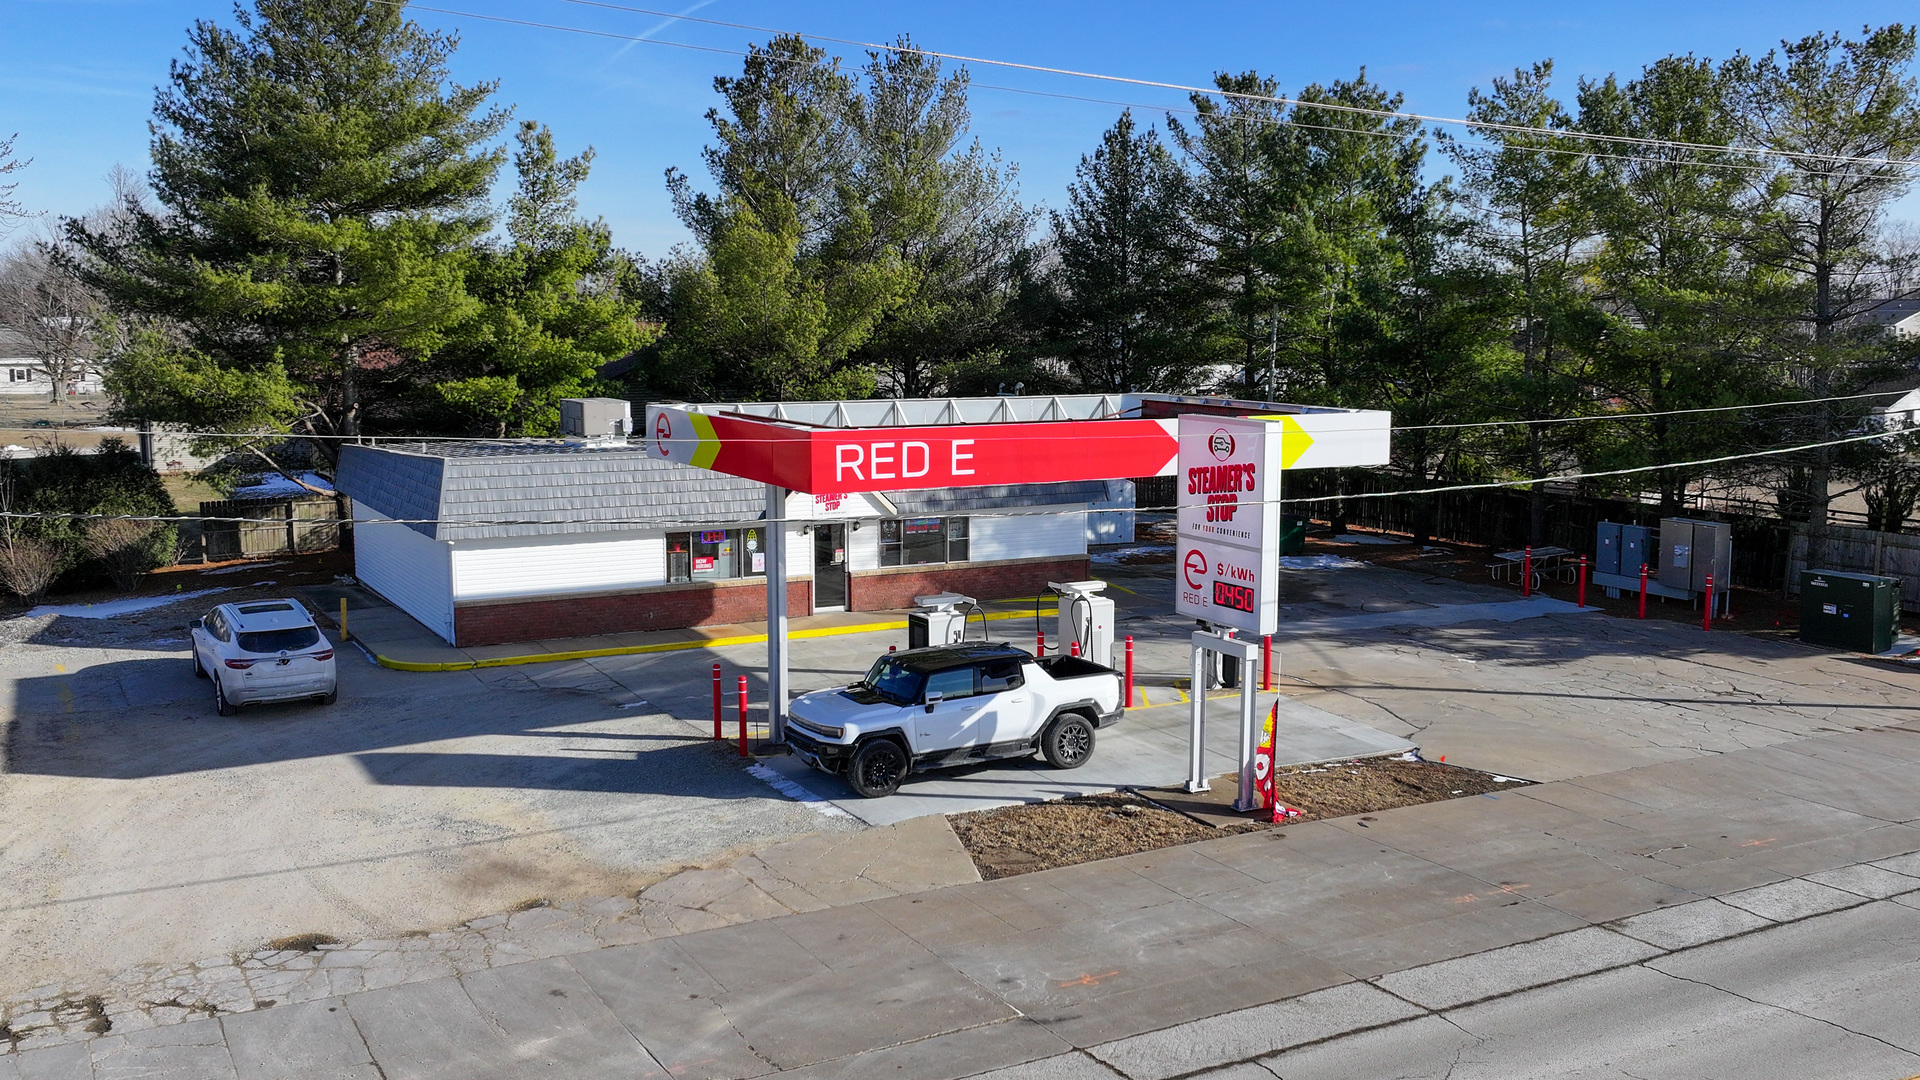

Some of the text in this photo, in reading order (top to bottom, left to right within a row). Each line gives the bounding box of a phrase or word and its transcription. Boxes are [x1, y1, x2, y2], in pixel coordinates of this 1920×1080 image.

[836, 439, 975, 482] RED E
[1188, 463, 1255, 495] STEAMER'S
[825, 500, 841, 512] STOP
[1206, 493, 1238, 522] STOP
[702, 531, 724, 542] OPEN
[1192, 522, 1251, 540] FOR YOUR CONVENIENCE
[1217, 562, 1255, 583] $/kWh
[1183, 591, 1208, 608] RED E
